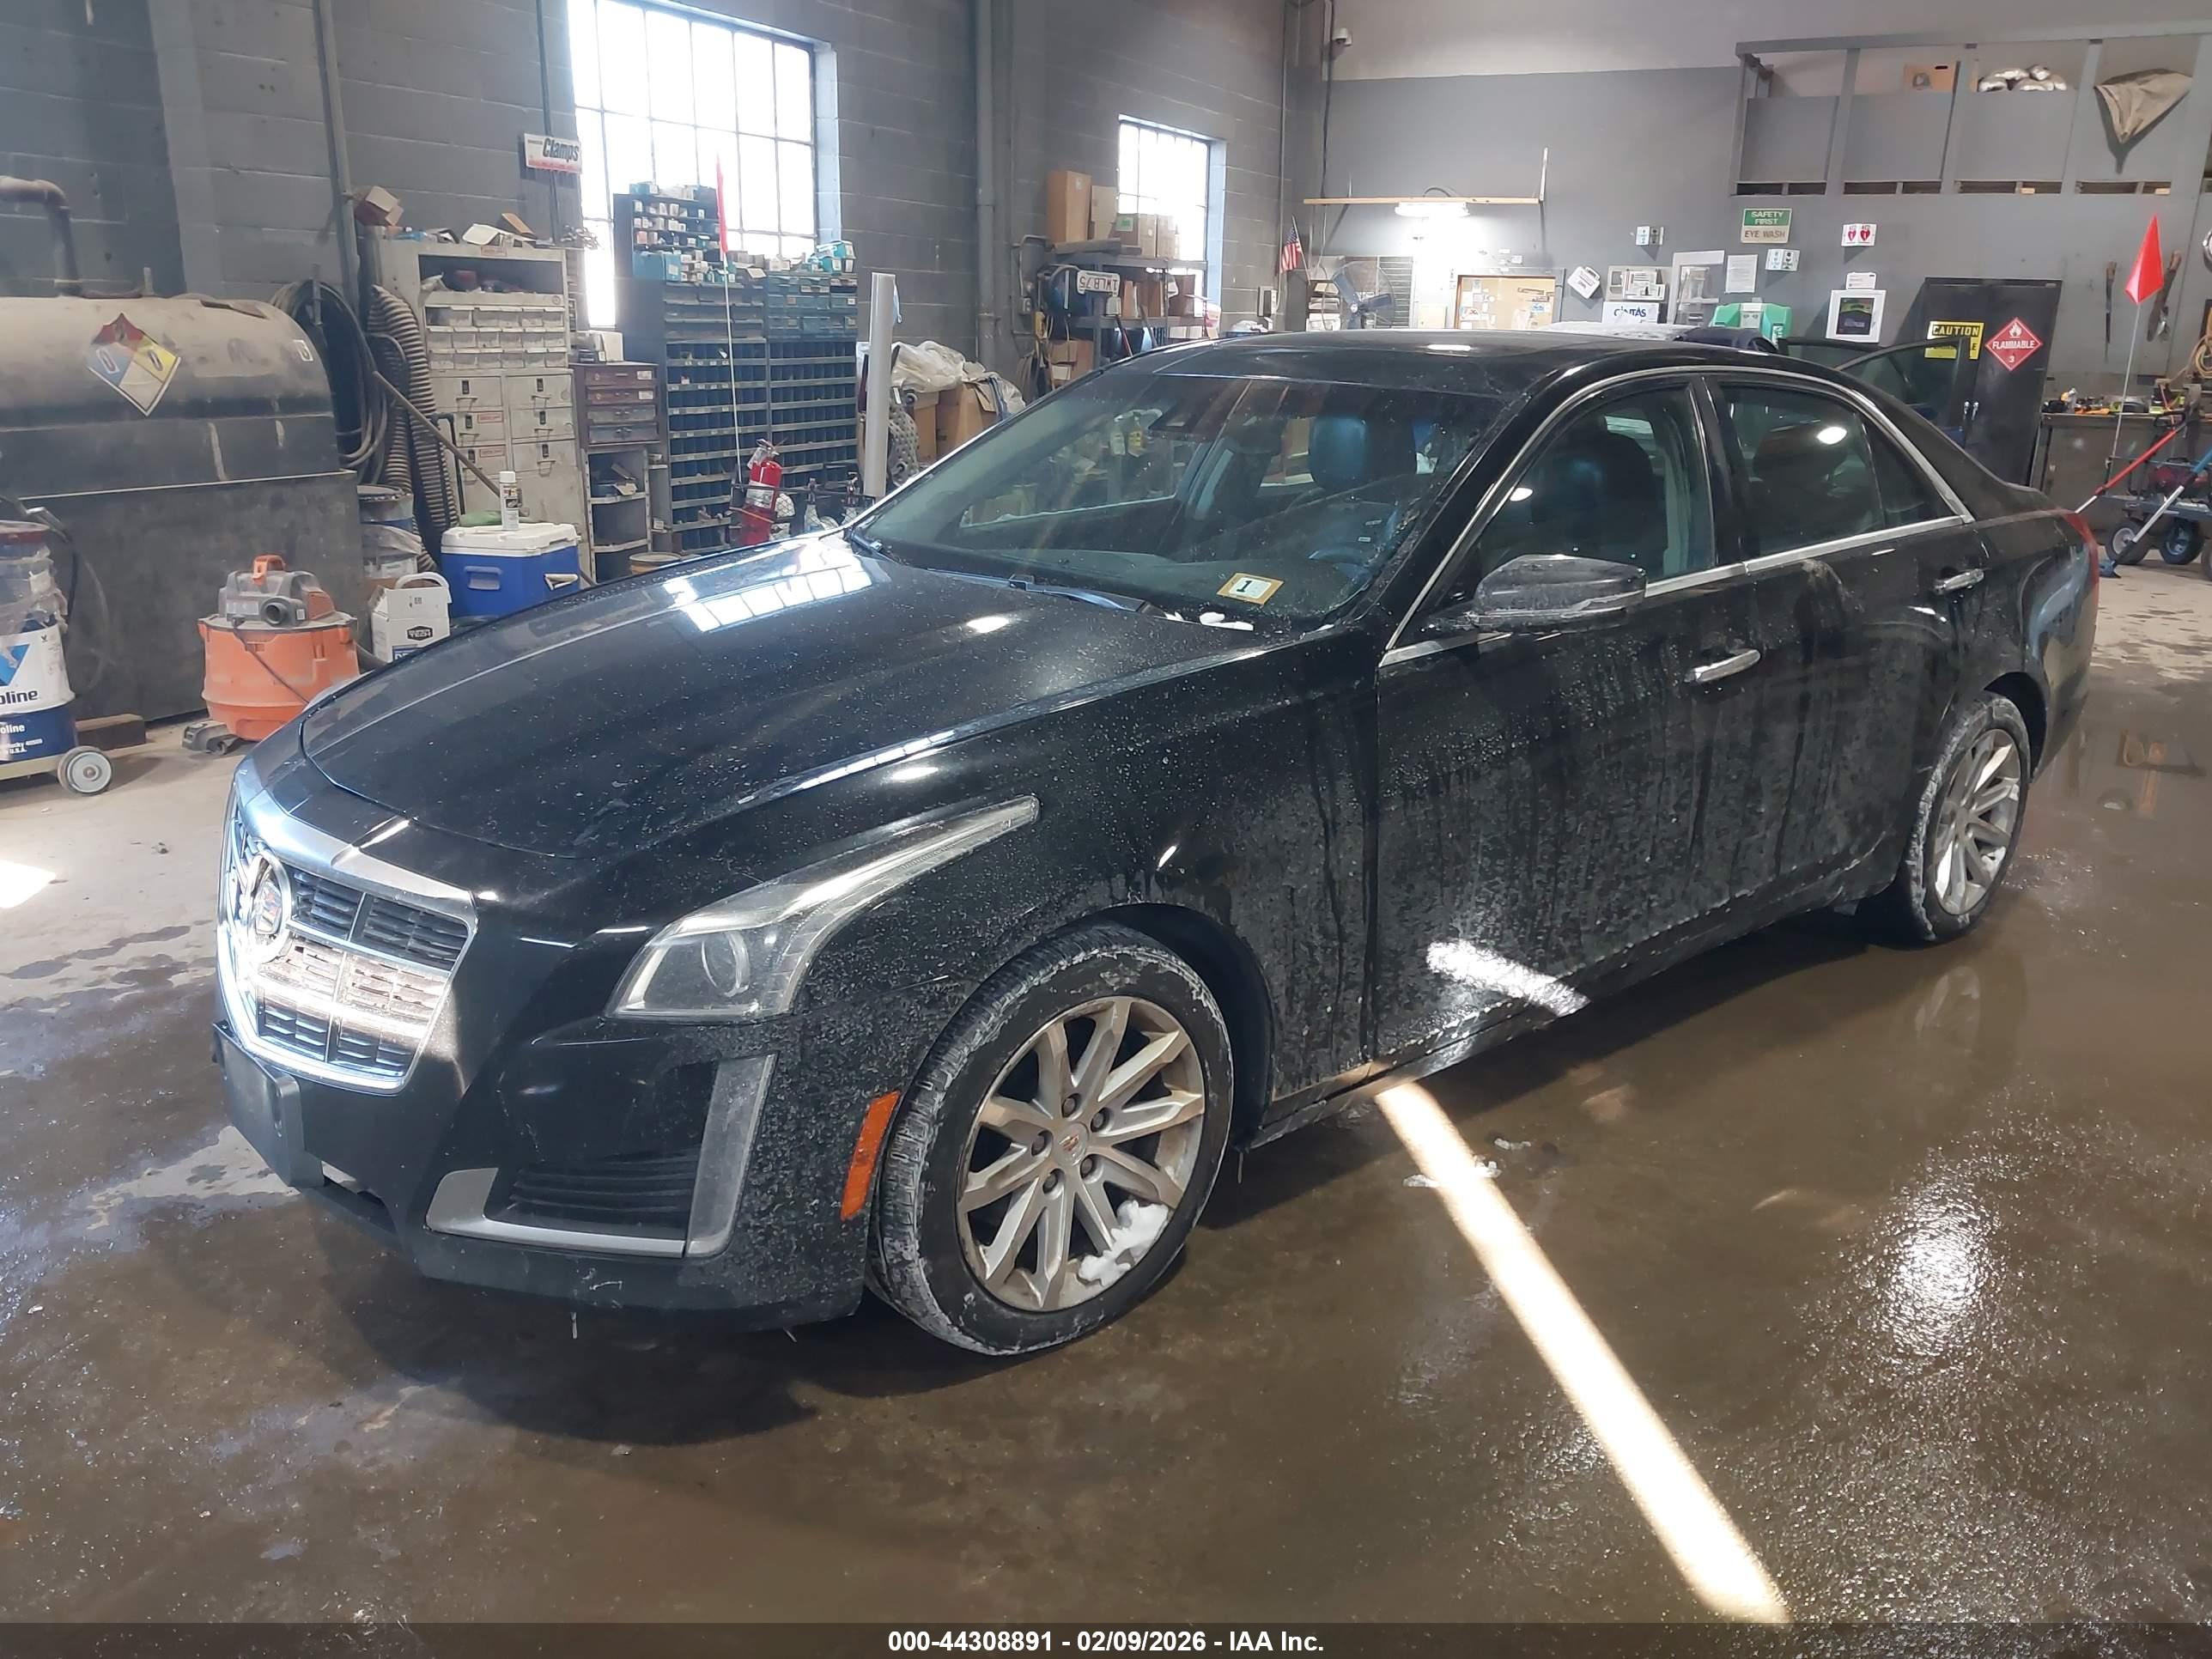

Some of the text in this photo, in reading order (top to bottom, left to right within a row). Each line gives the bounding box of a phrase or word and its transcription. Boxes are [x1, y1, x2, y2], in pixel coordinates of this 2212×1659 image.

[543, 137, 580, 162] Clamps
[1744, 229, 1786, 239] EYE WASH
[1932, 325, 1979, 337] CAUTION
[1992, 339, 2036, 350] FLAMMABLE
[2008, 355, 2015, 363] 3
[1236, 580, 1252, 592] 1
